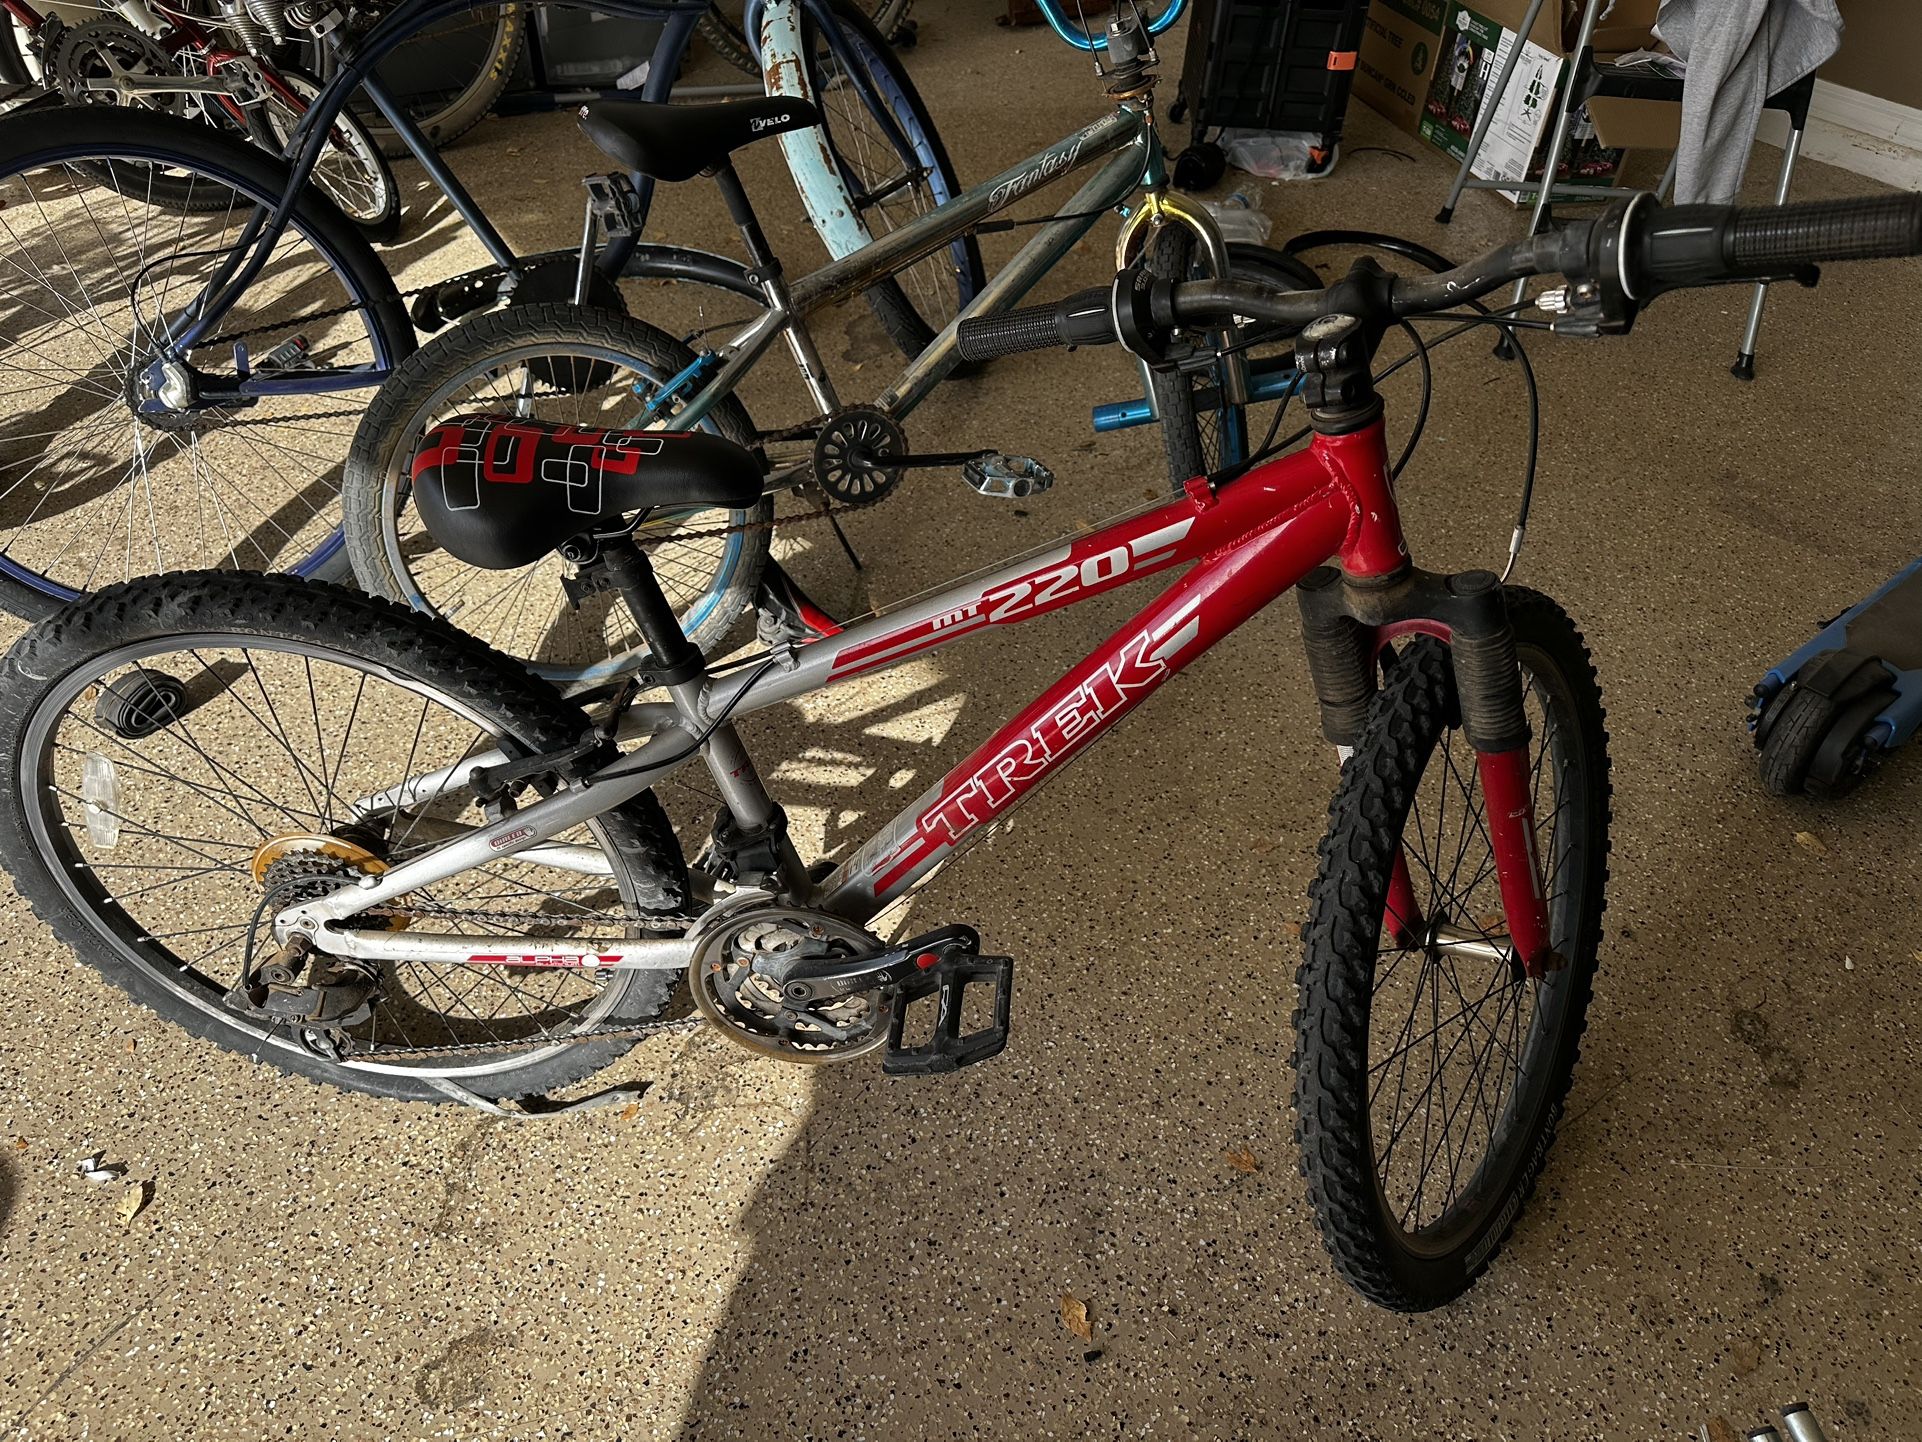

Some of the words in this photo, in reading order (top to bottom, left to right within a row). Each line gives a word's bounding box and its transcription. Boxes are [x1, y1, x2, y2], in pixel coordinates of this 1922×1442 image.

[759, 113, 791, 128] VELO
[987, 140, 1083, 213] Fantasy
[988, 545, 1130, 624] 220
[921, 629, 1168, 841] TREK
[1518, 1101, 1558, 1199] BONTRAGER
